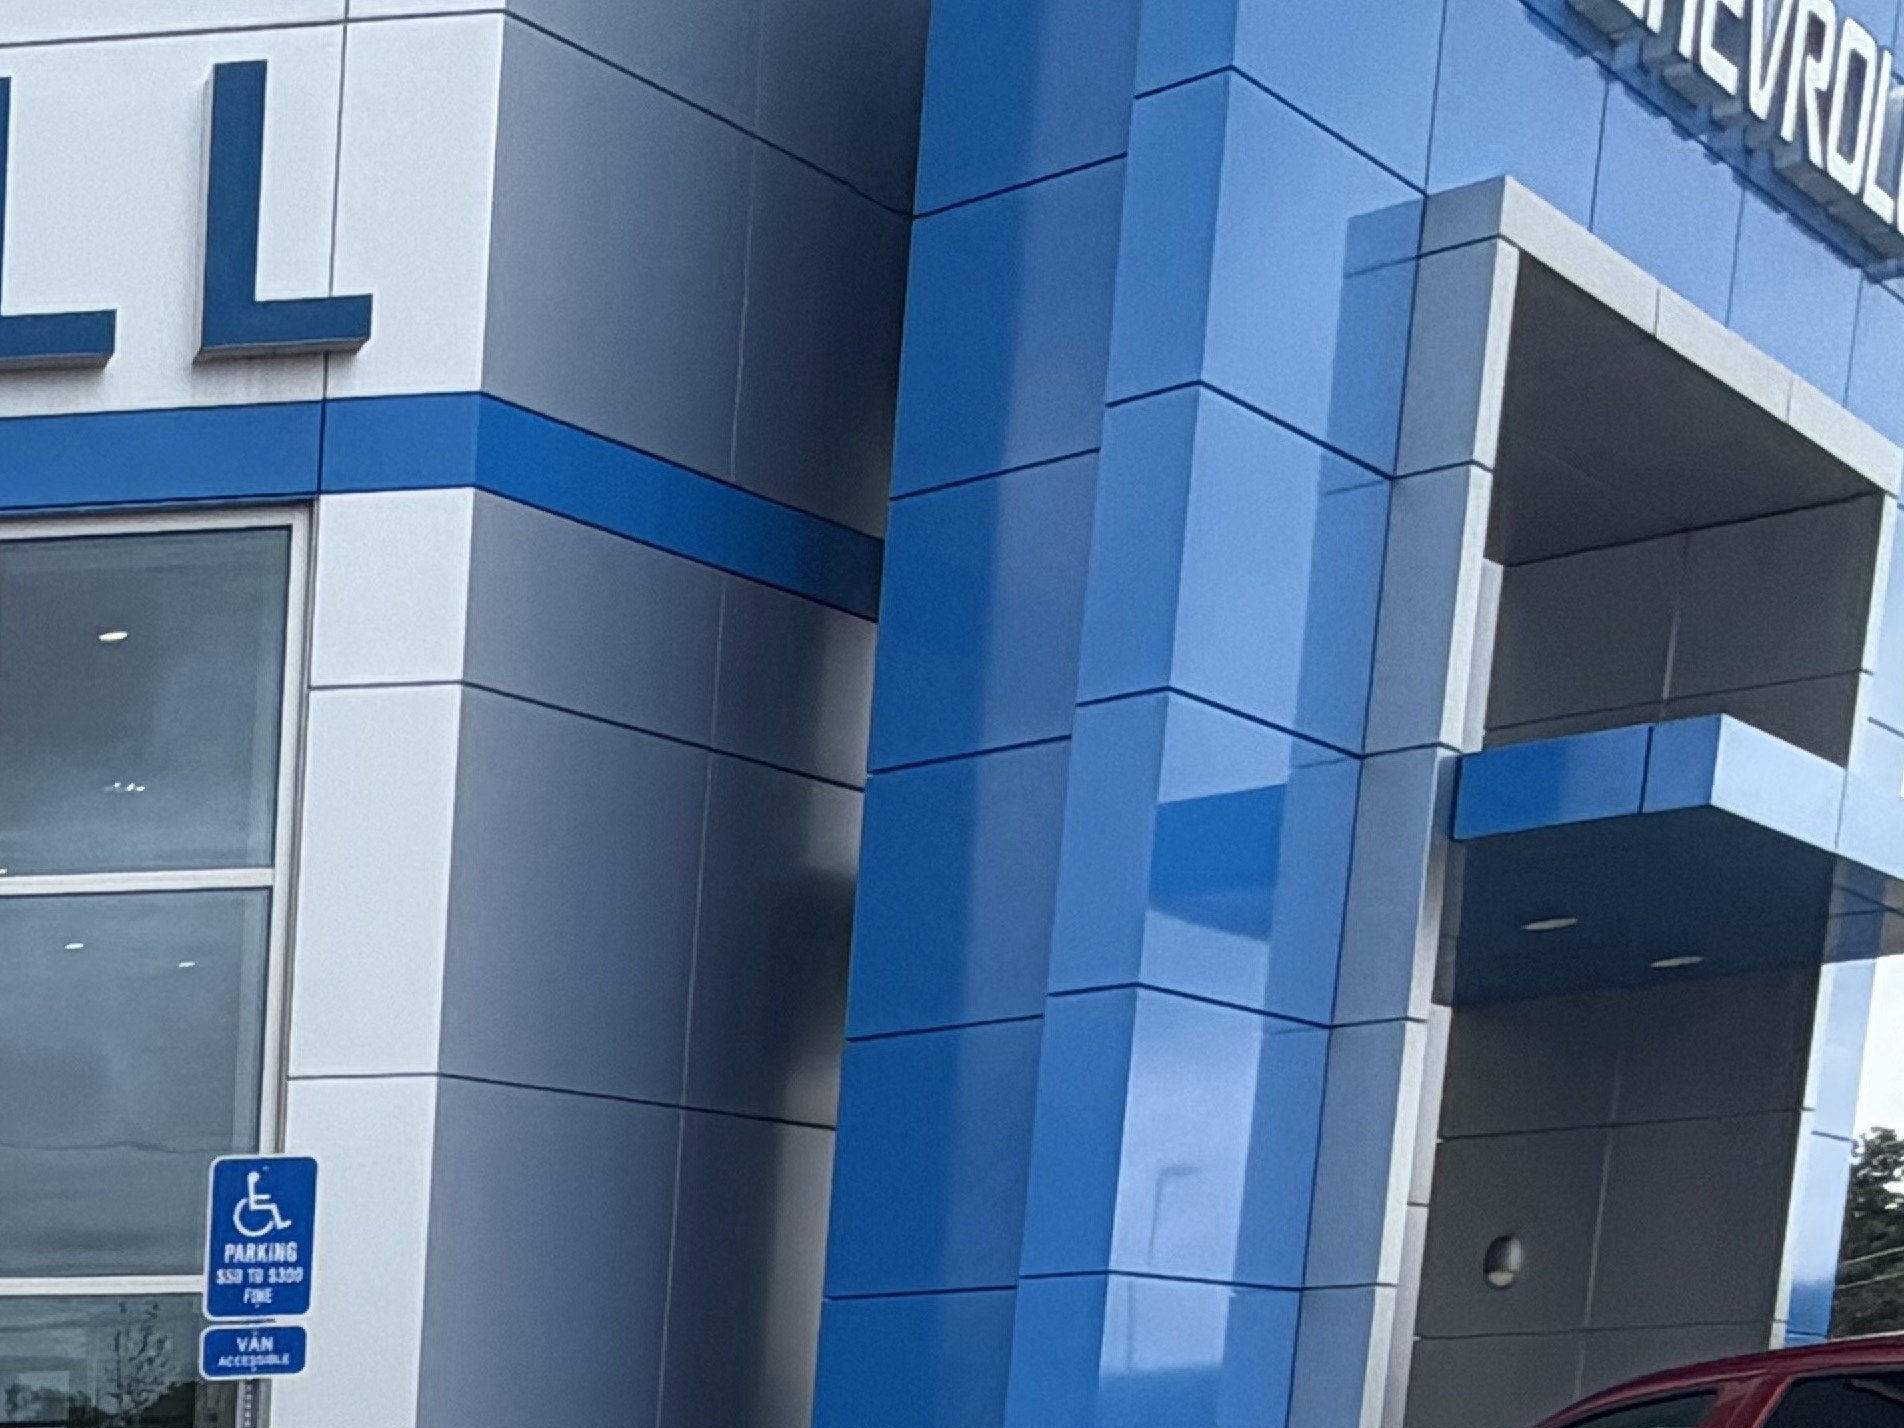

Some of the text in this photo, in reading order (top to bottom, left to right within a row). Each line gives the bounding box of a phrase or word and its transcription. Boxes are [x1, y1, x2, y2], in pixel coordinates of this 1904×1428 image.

[224, 1241, 298, 1264] PARKING
[248, 1268, 264, 1284] TO
[243, 1287, 273, 1304] FINE
[236, 1336, 274, 1352] VAN
[218, 1353, 290, 1368] ACCESSIBLE
